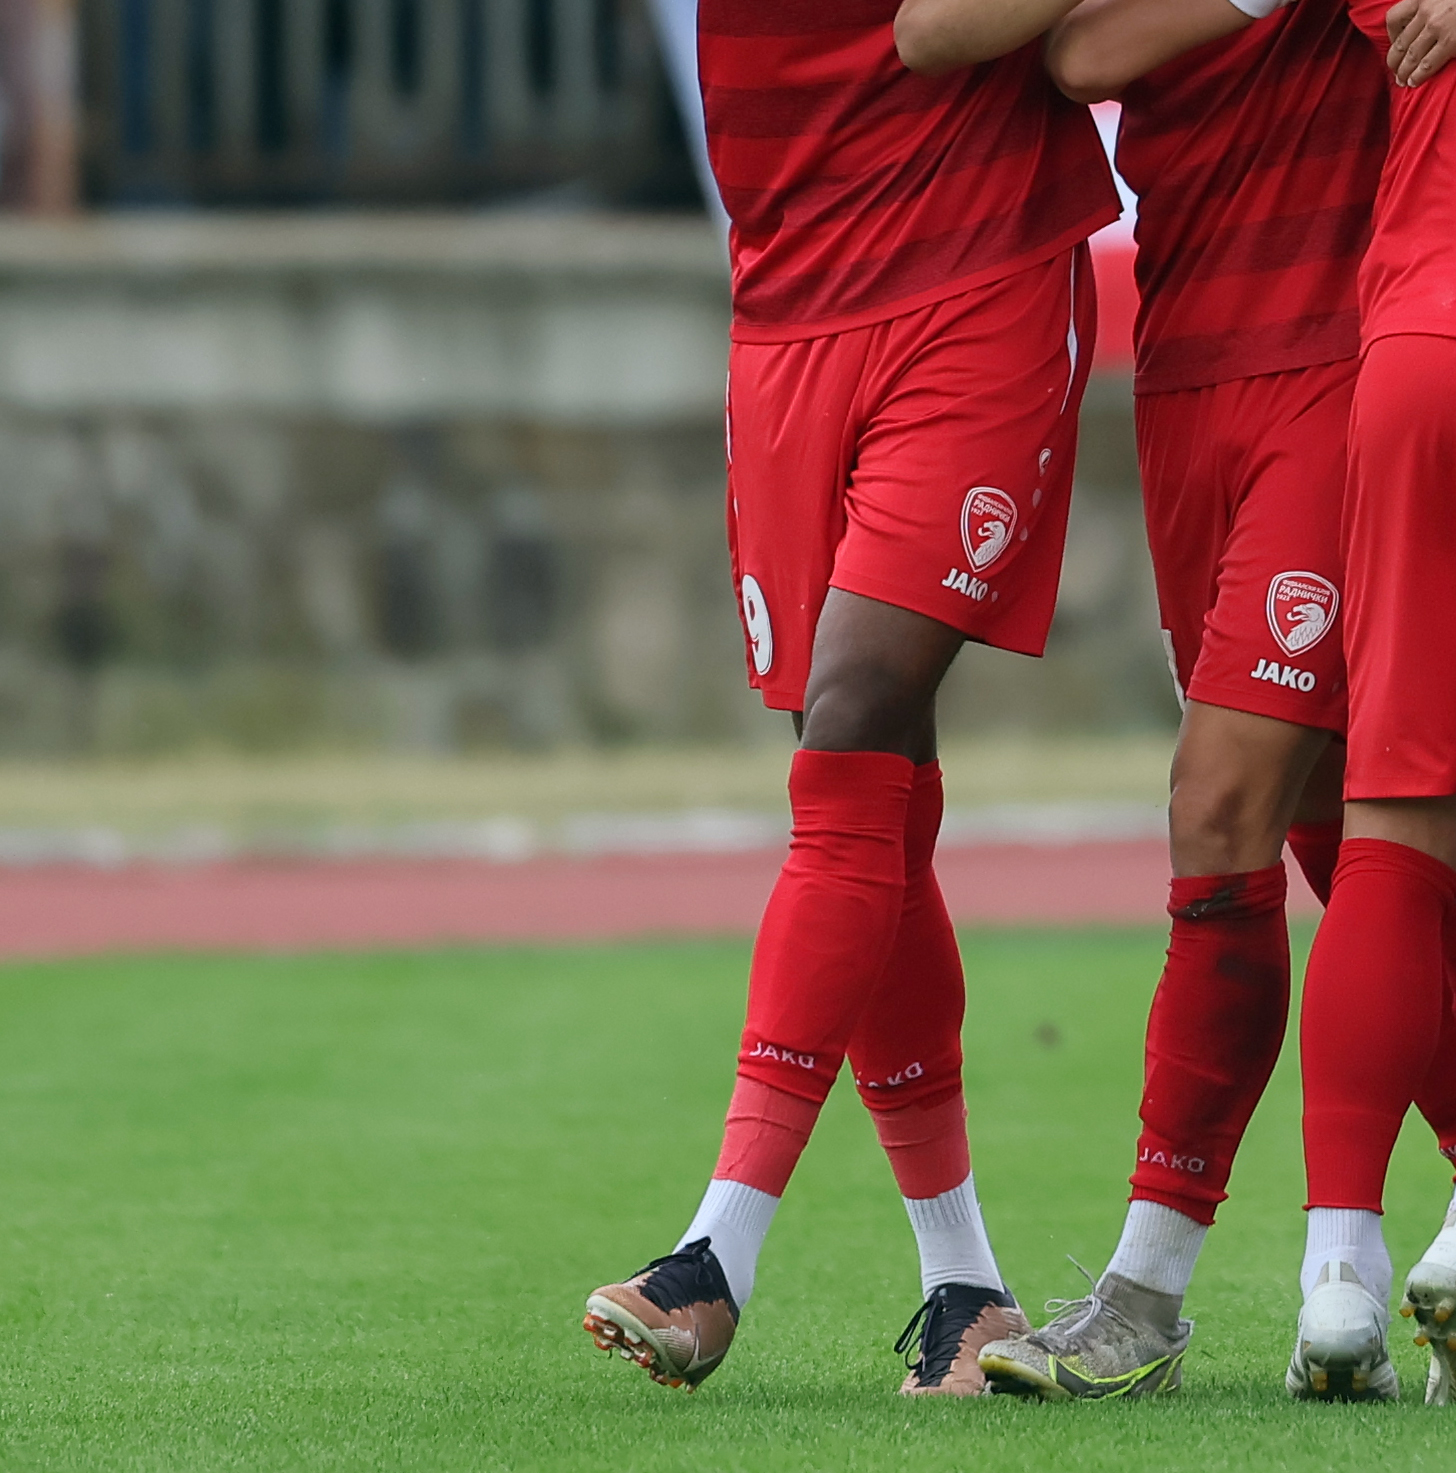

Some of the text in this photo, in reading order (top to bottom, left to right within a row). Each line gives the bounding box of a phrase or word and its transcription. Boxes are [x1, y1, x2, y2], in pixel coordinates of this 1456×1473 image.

[942, 568, 988, 601] JAKO
[742, 574, 773, 676] 9
[1251, 658, 1316, 692] JAKO
[749, 1042, 815, 1070] JAKO
[1139, 1147, 1205, 1173] JAKO
